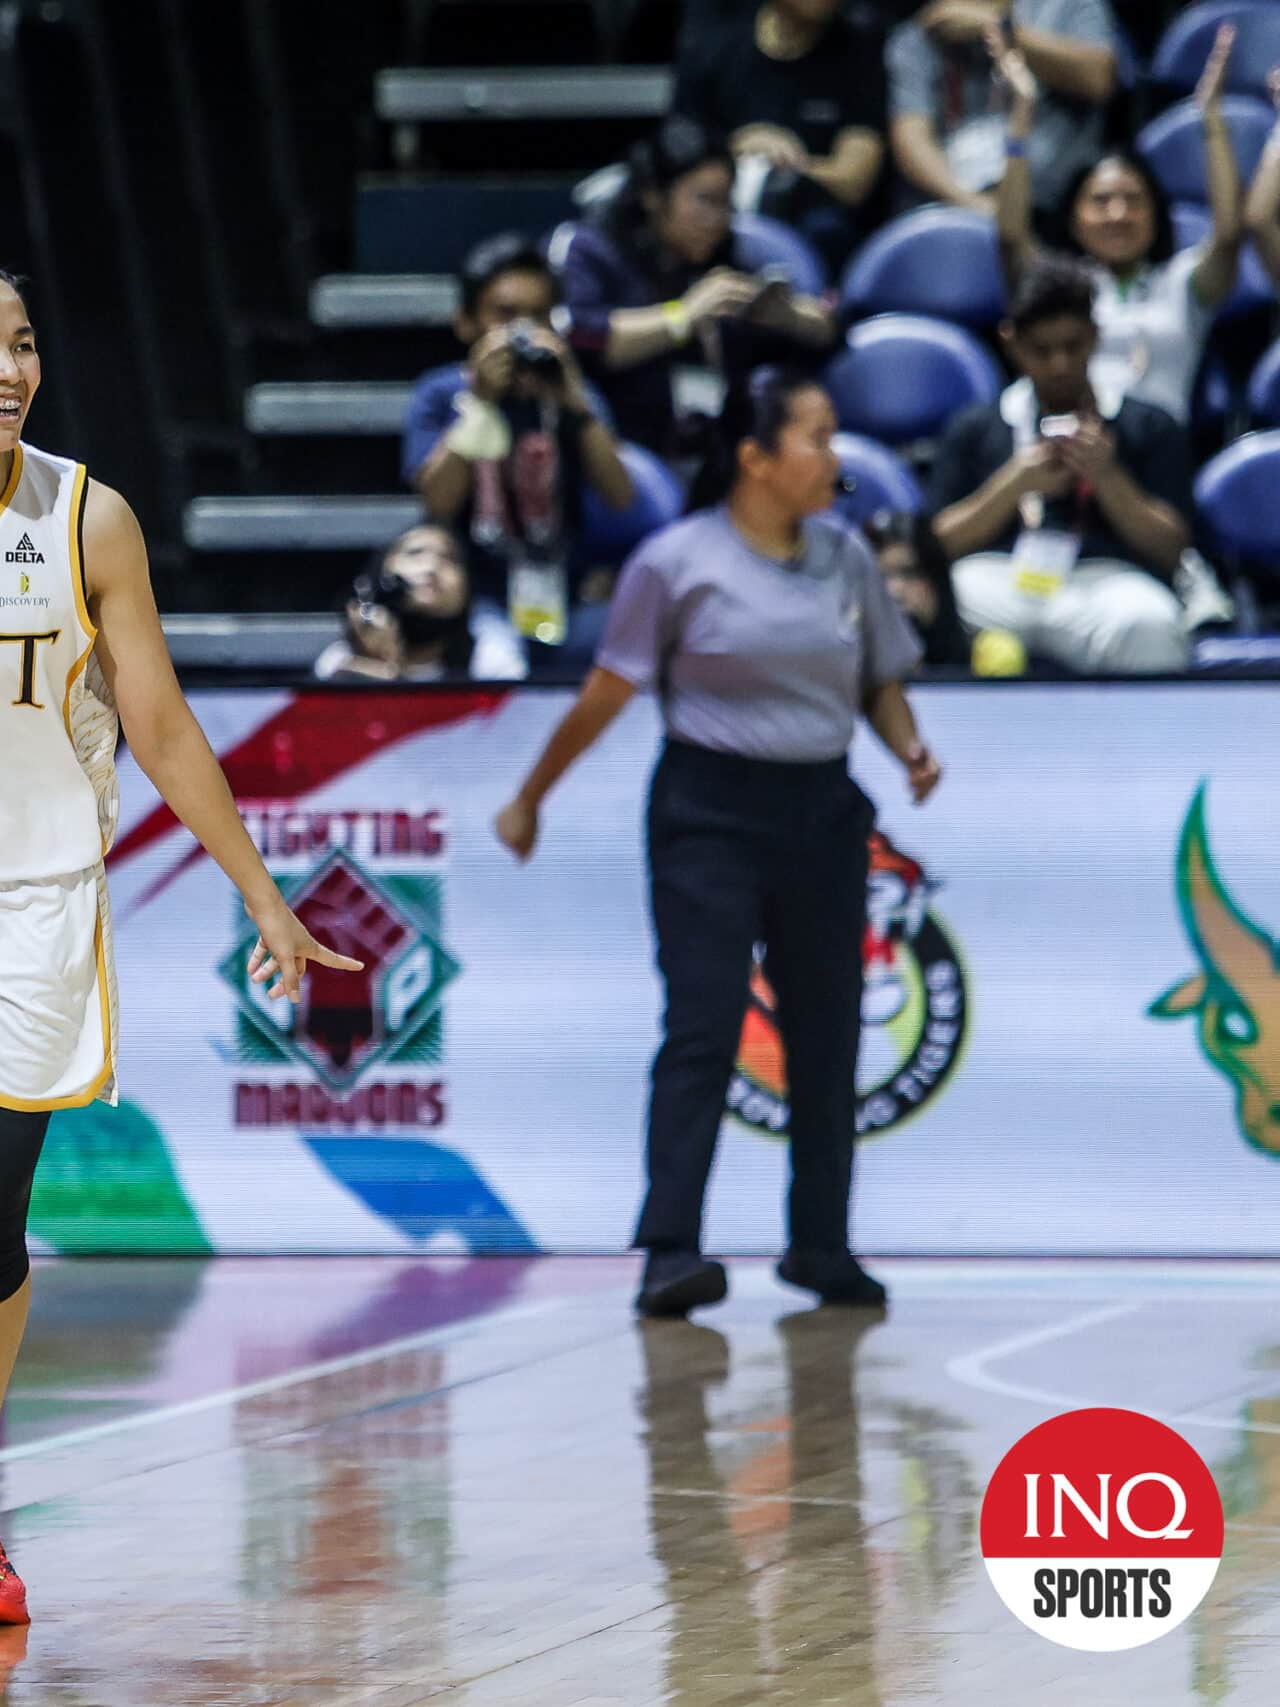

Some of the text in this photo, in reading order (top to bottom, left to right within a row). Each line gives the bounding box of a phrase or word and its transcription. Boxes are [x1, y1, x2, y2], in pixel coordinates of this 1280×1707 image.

[5, 551, 45, 564] DELTA
[0, 597, 50, 608] DISCOVERY
[239, 810, 446, 858] IGHTING
